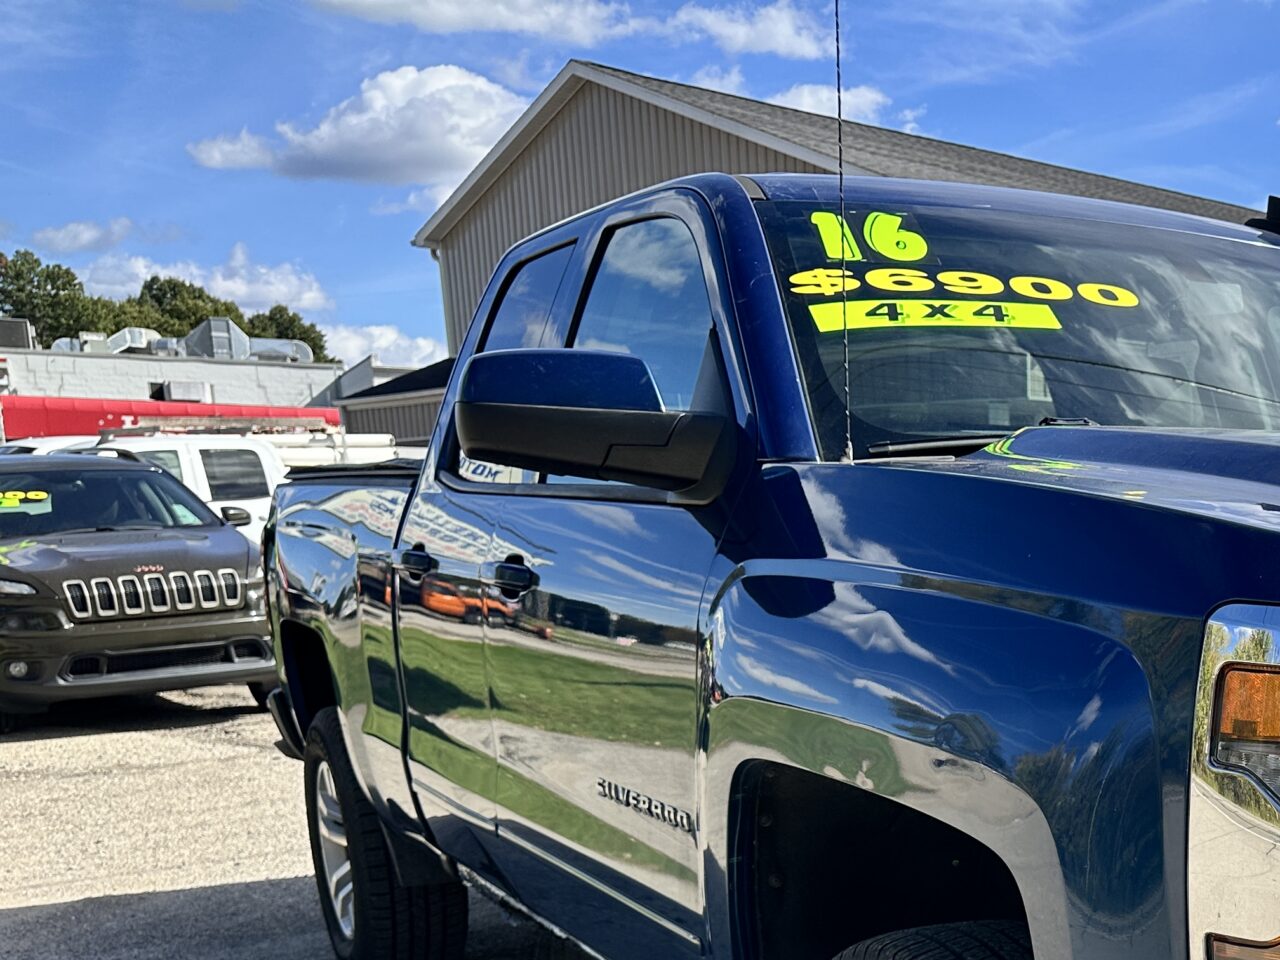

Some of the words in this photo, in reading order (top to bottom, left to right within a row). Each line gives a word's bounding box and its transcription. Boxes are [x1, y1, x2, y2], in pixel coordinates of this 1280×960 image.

[810, 211, 929, 262] 16
[788, 267, 1140, 308] $6900
[0, 490, 48, 501] 00
[597, 777, 693, 833] SILVERADO
